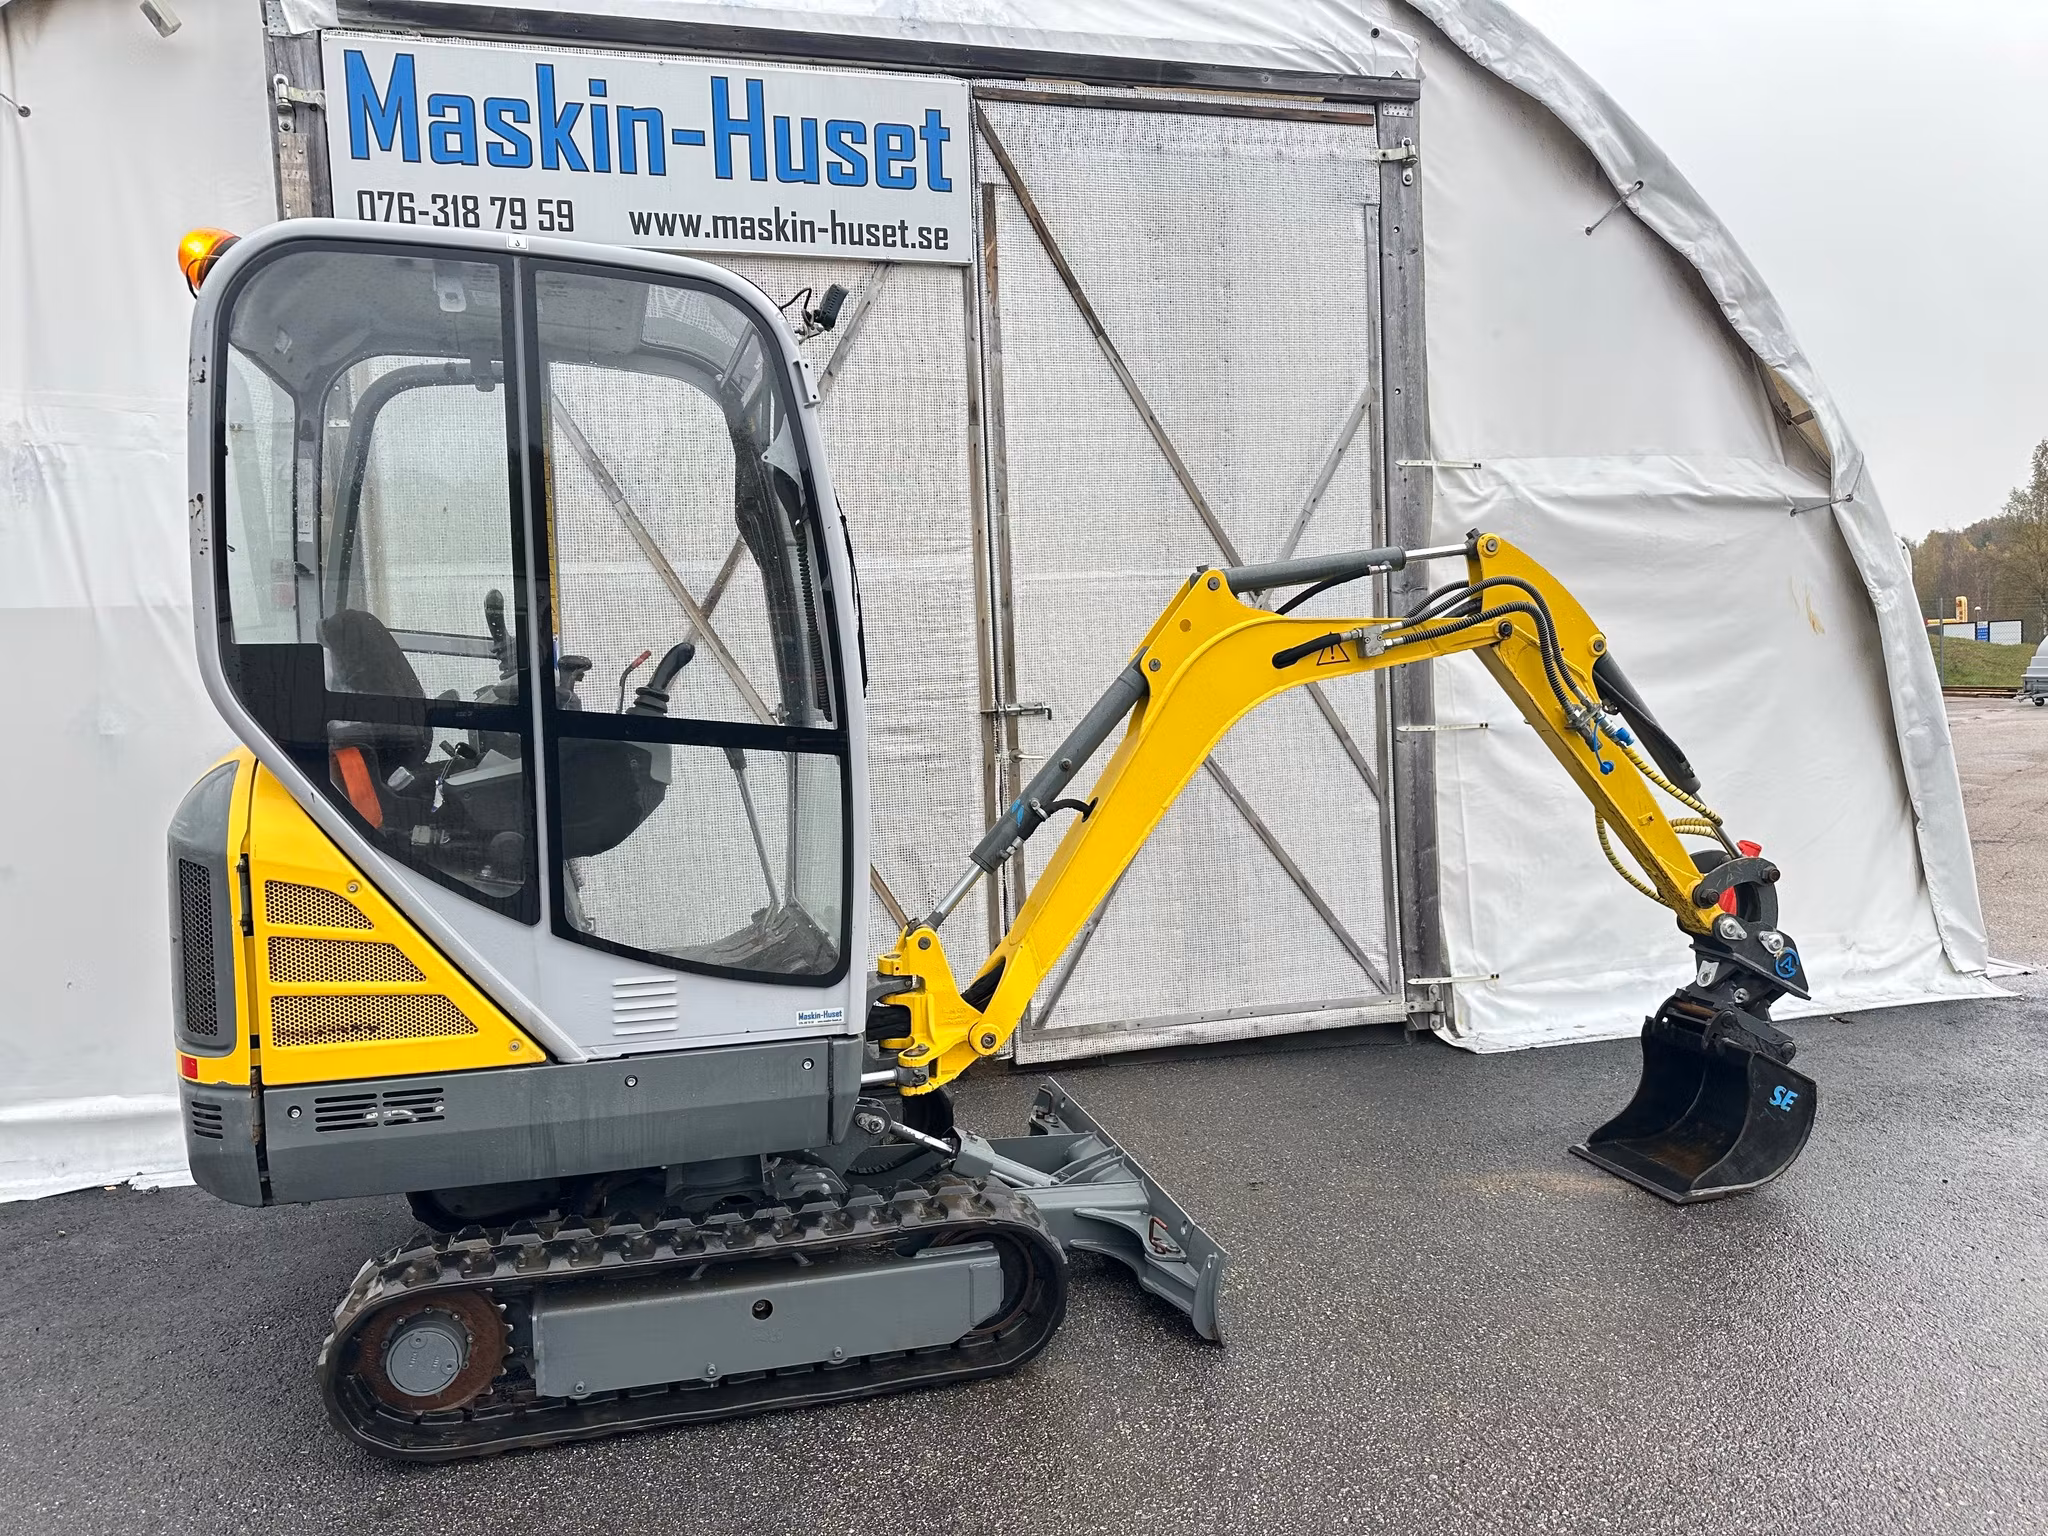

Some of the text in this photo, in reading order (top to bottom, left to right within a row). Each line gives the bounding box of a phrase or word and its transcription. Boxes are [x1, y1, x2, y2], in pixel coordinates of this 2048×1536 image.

[343, 49, 954, 193] Maskin-Huset
[356, 189, 575, 233] 076-318 79 59
[628, 206, 949, 251] www.maskin-huset.se
[1769, 1085, 1799, 1112] SE
